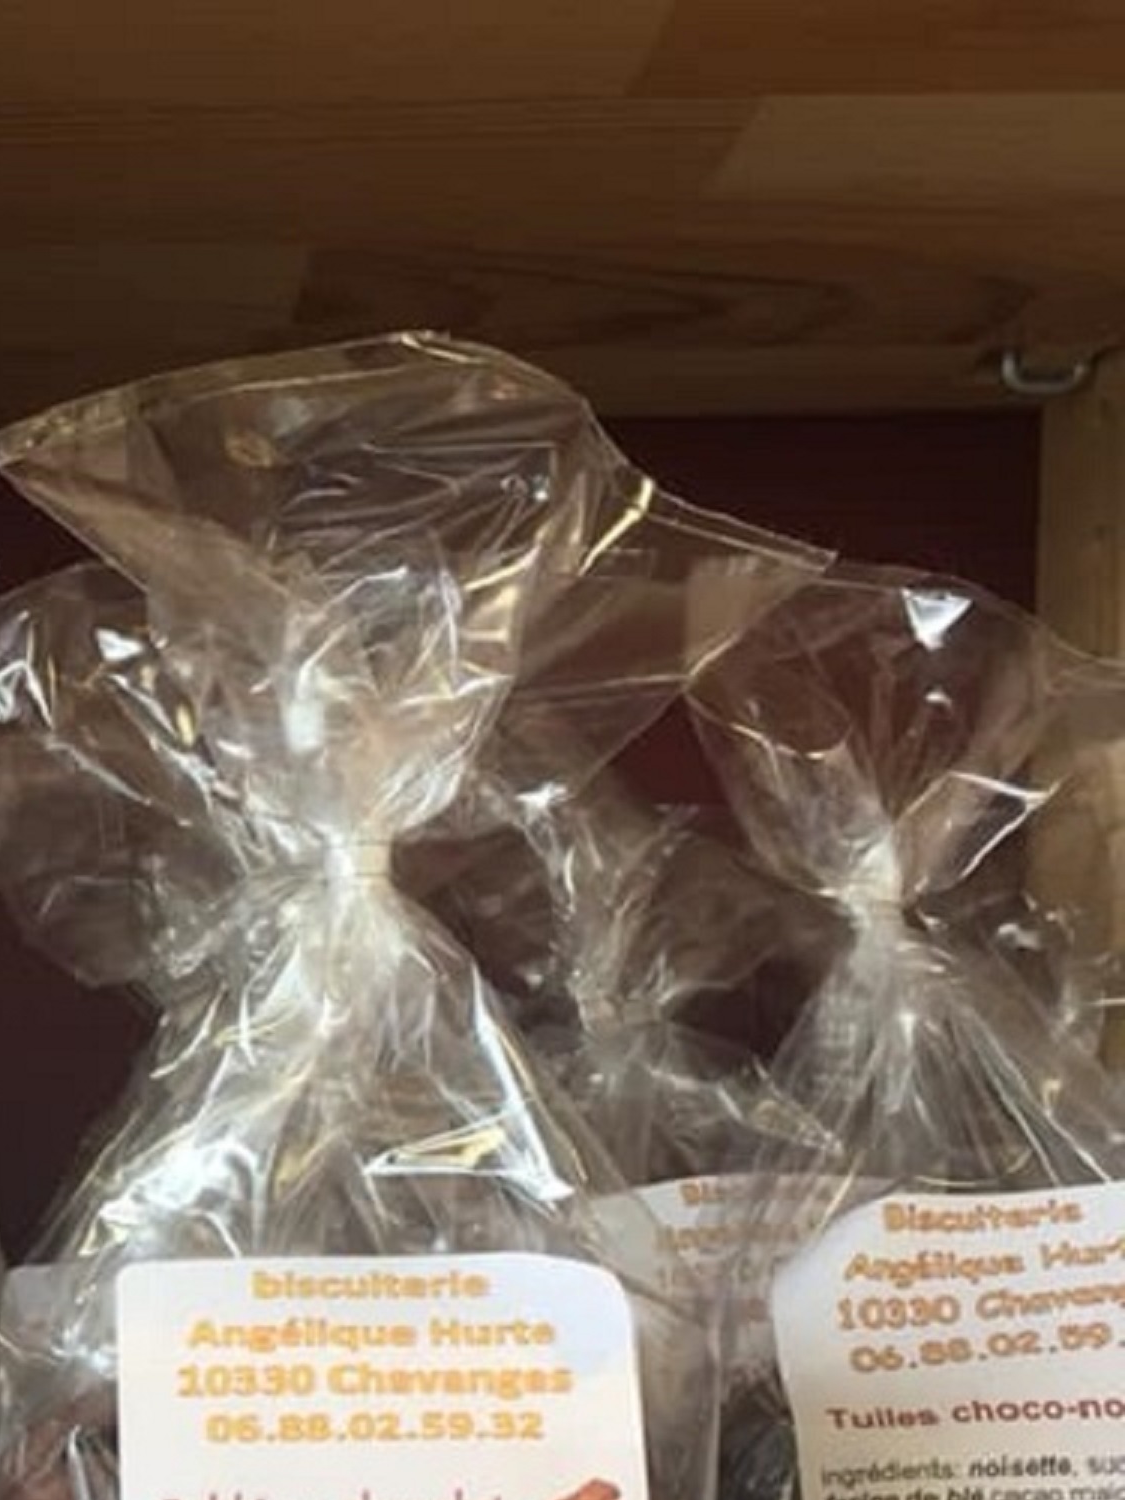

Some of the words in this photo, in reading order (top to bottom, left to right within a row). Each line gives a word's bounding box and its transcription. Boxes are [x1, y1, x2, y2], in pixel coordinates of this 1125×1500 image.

[837, 1294, 961, 1331] 10330
[187, 1317, 417, 1351] Angélique
[429, 1317, 555, 1346] Hurte
[177, 1365, 316, 1397] 10330
[206, 1412, 544, 1444] 06.88.02.59.32
[826, 1406, 940, 1431] Tuiles
